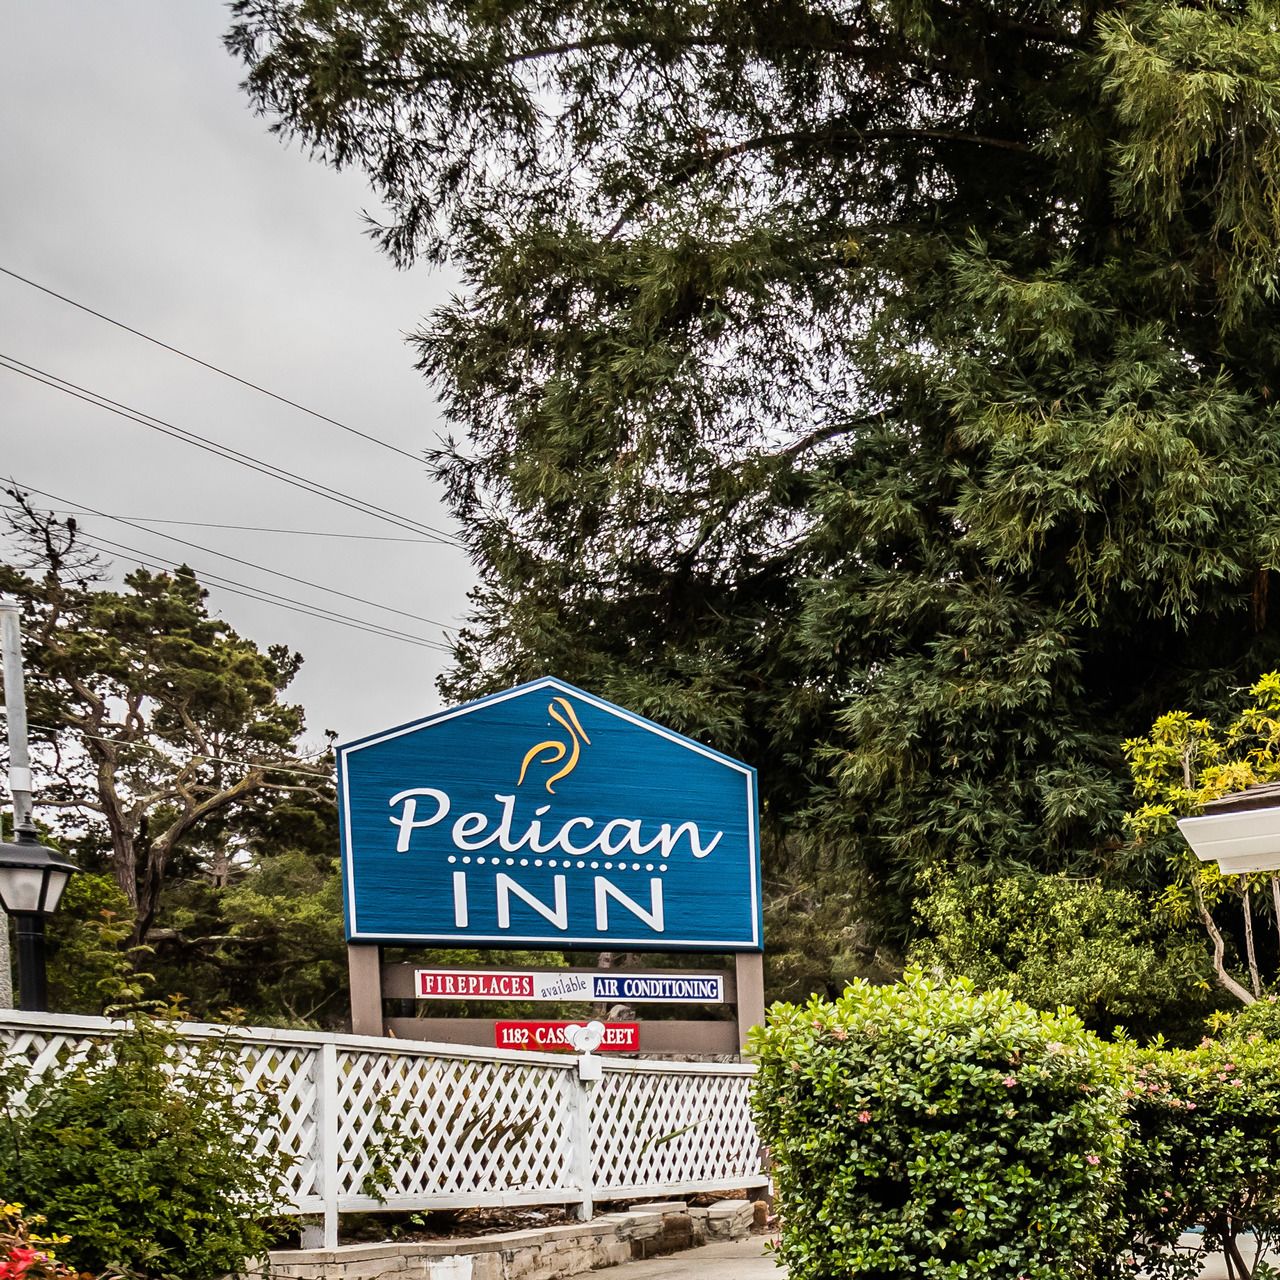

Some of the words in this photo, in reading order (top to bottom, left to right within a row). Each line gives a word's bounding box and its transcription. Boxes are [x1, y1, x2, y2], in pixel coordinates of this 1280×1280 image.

[389, 787, 723, 858] Pelican
[453, 871, 665, 932] INN
[425, 976, 531, 994] FIREPLACES
[541, 976, 587, 998] available
[595, 979, 618, 996] AIR
[626, 979, 718, 998] CONDITIONING
[502, 1028, 528, 1044] 1182
